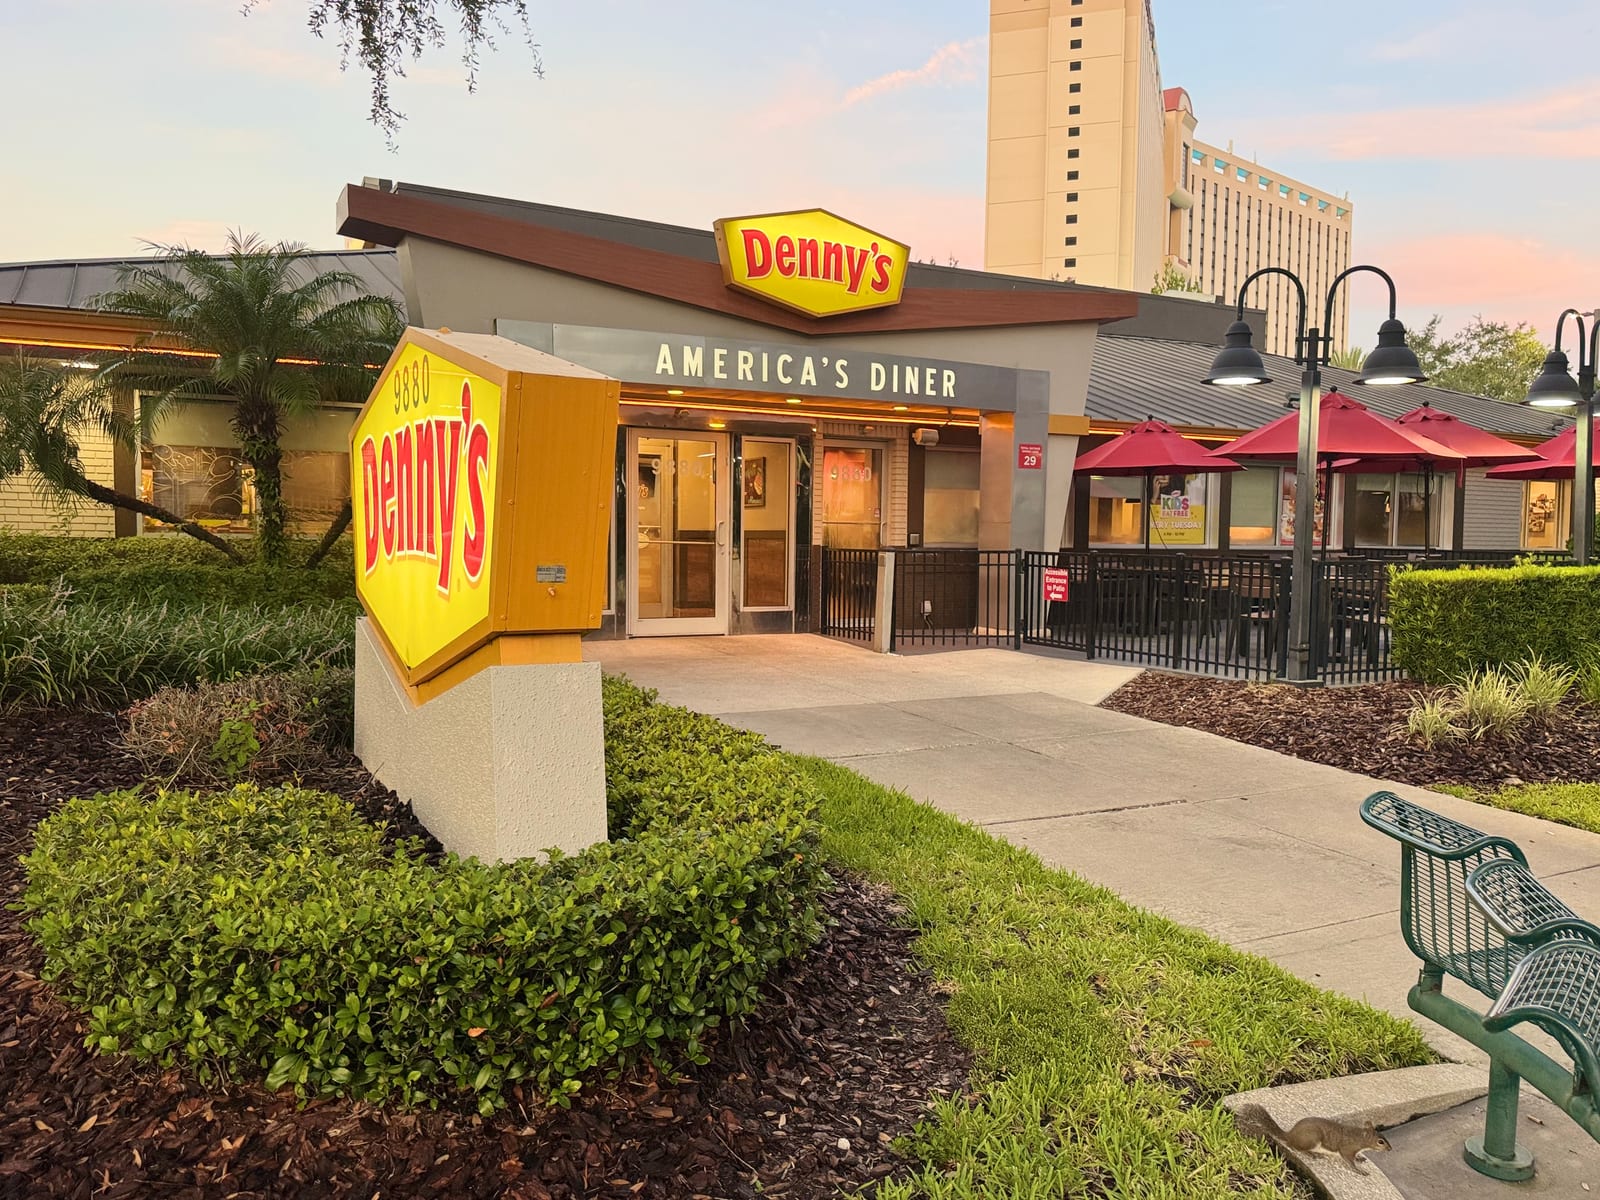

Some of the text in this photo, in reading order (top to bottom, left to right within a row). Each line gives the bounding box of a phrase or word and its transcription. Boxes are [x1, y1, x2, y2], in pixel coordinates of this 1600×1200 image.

[740, 228, 893, 295] Denny's
[655, 343, 956, 397] AMERICA'S DINER
[393, 354, 430, 415] 9880
[1023, 455, 1037, 466] 29
[360, 379, 489, 594] Denny's
[1162, 496, 1189, 510] KIDS
[1171, 521, 1202, 529] TUESDAY
[1045, 568, 1068, 576] Accessible
[1045, 575, 1067, 584] Entrance
[1052, 584, 1066, 592] Patio
